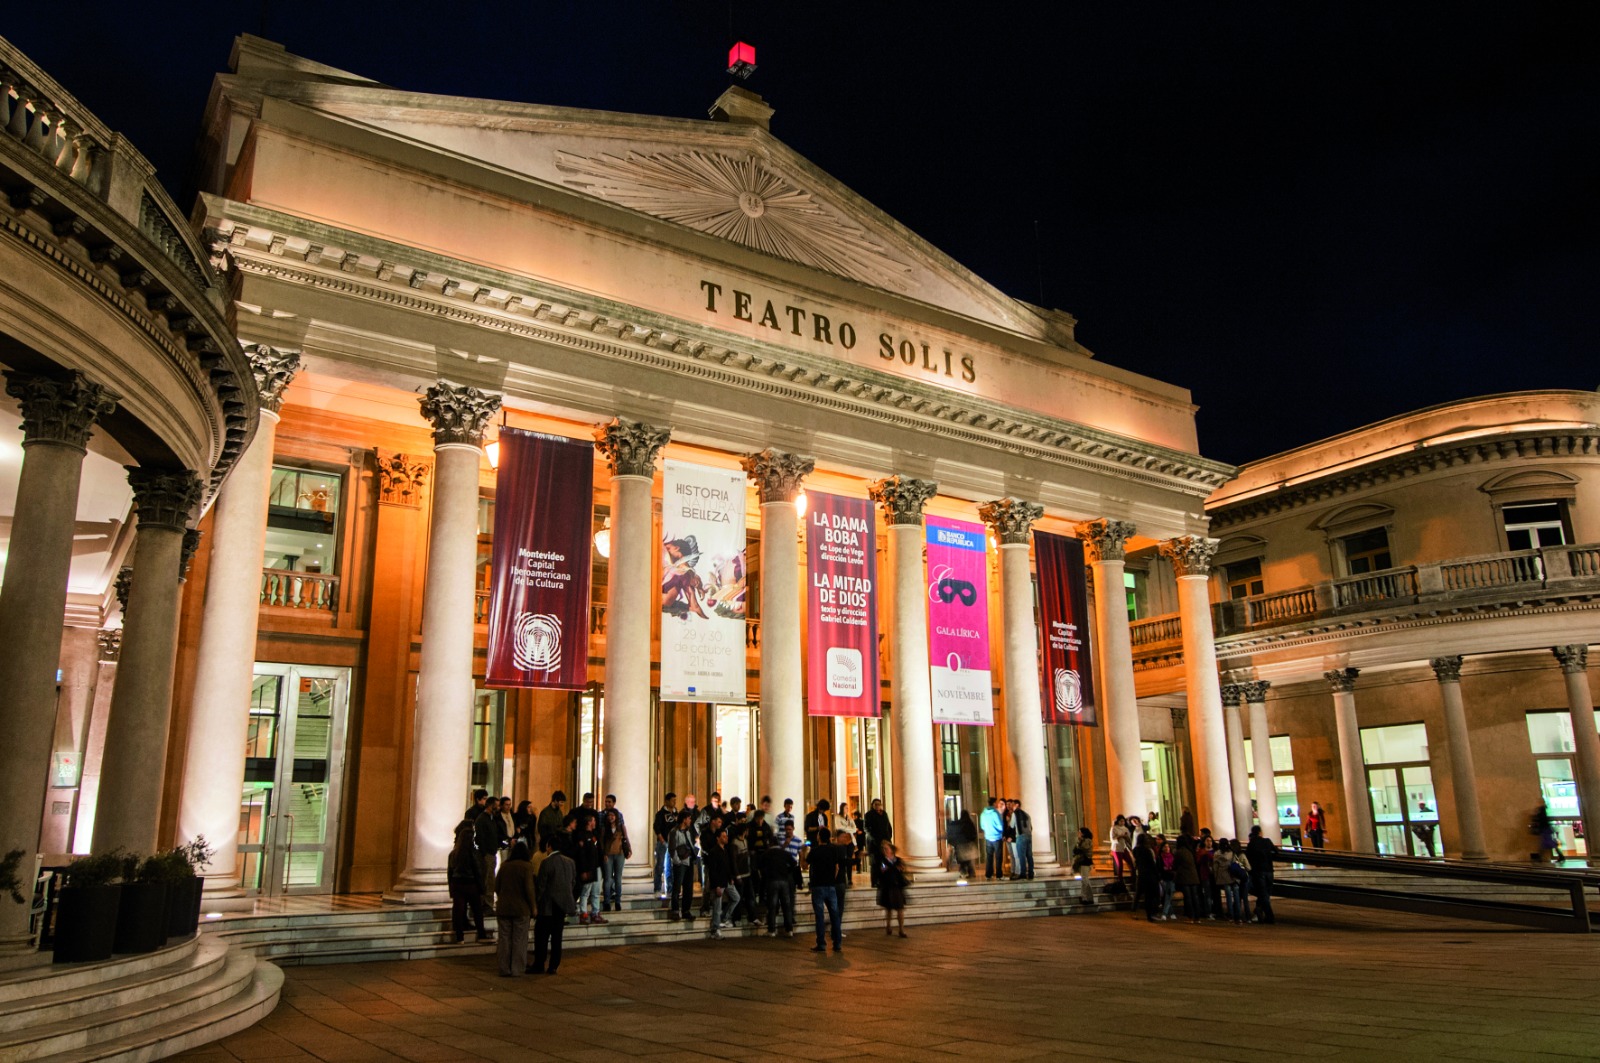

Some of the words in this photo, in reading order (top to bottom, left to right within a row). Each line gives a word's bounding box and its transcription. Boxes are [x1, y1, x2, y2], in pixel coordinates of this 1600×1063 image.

[700, 279, 858, 351] TEATRO
[879, 331, 977, 385] SOLIS
[676, 482, 729, 502] HISTORIA
[682, 506, 731, 524] BELLEZA
[813, 511, 830, 528] LA
[832, 514, 869, 534] DAMA
[825, 528, 859, 546] BOBA
[519, 548, 566, 561] Montevideo
[820, 543, 828, 551] de
[828, 544, 842, 554] Lope
[843, 546, 850, 554] de
[851, 547, 864, 559] Vega
[528, 559, 556, 571] Capital
[511, 565, 572, 581] Iberoamericana
[515, 576, 525, 585] de
[526, 577, 534, 586] la
[535, 578, 564, 589] Cultura
[814, 572, 831, 588] LA
[833, 575, 872, 593] MITAD
[820, 588, 836, 604] DE
[840, 590, 868, 608] DIOS
[821, 614, 842, 624] Gabriel
[682, 628, 697, 640] 29
[709, 630, 723, 642] 30
[936, 625, 956, 637] GALA
[674, 641, 688, 653] de
[690, 643, 732, 656] octubre
[690, 655, 700, 667] 21
[702, 656, 715, 668] hs
[937, 688, 986, 701] NOVIEMBRE
